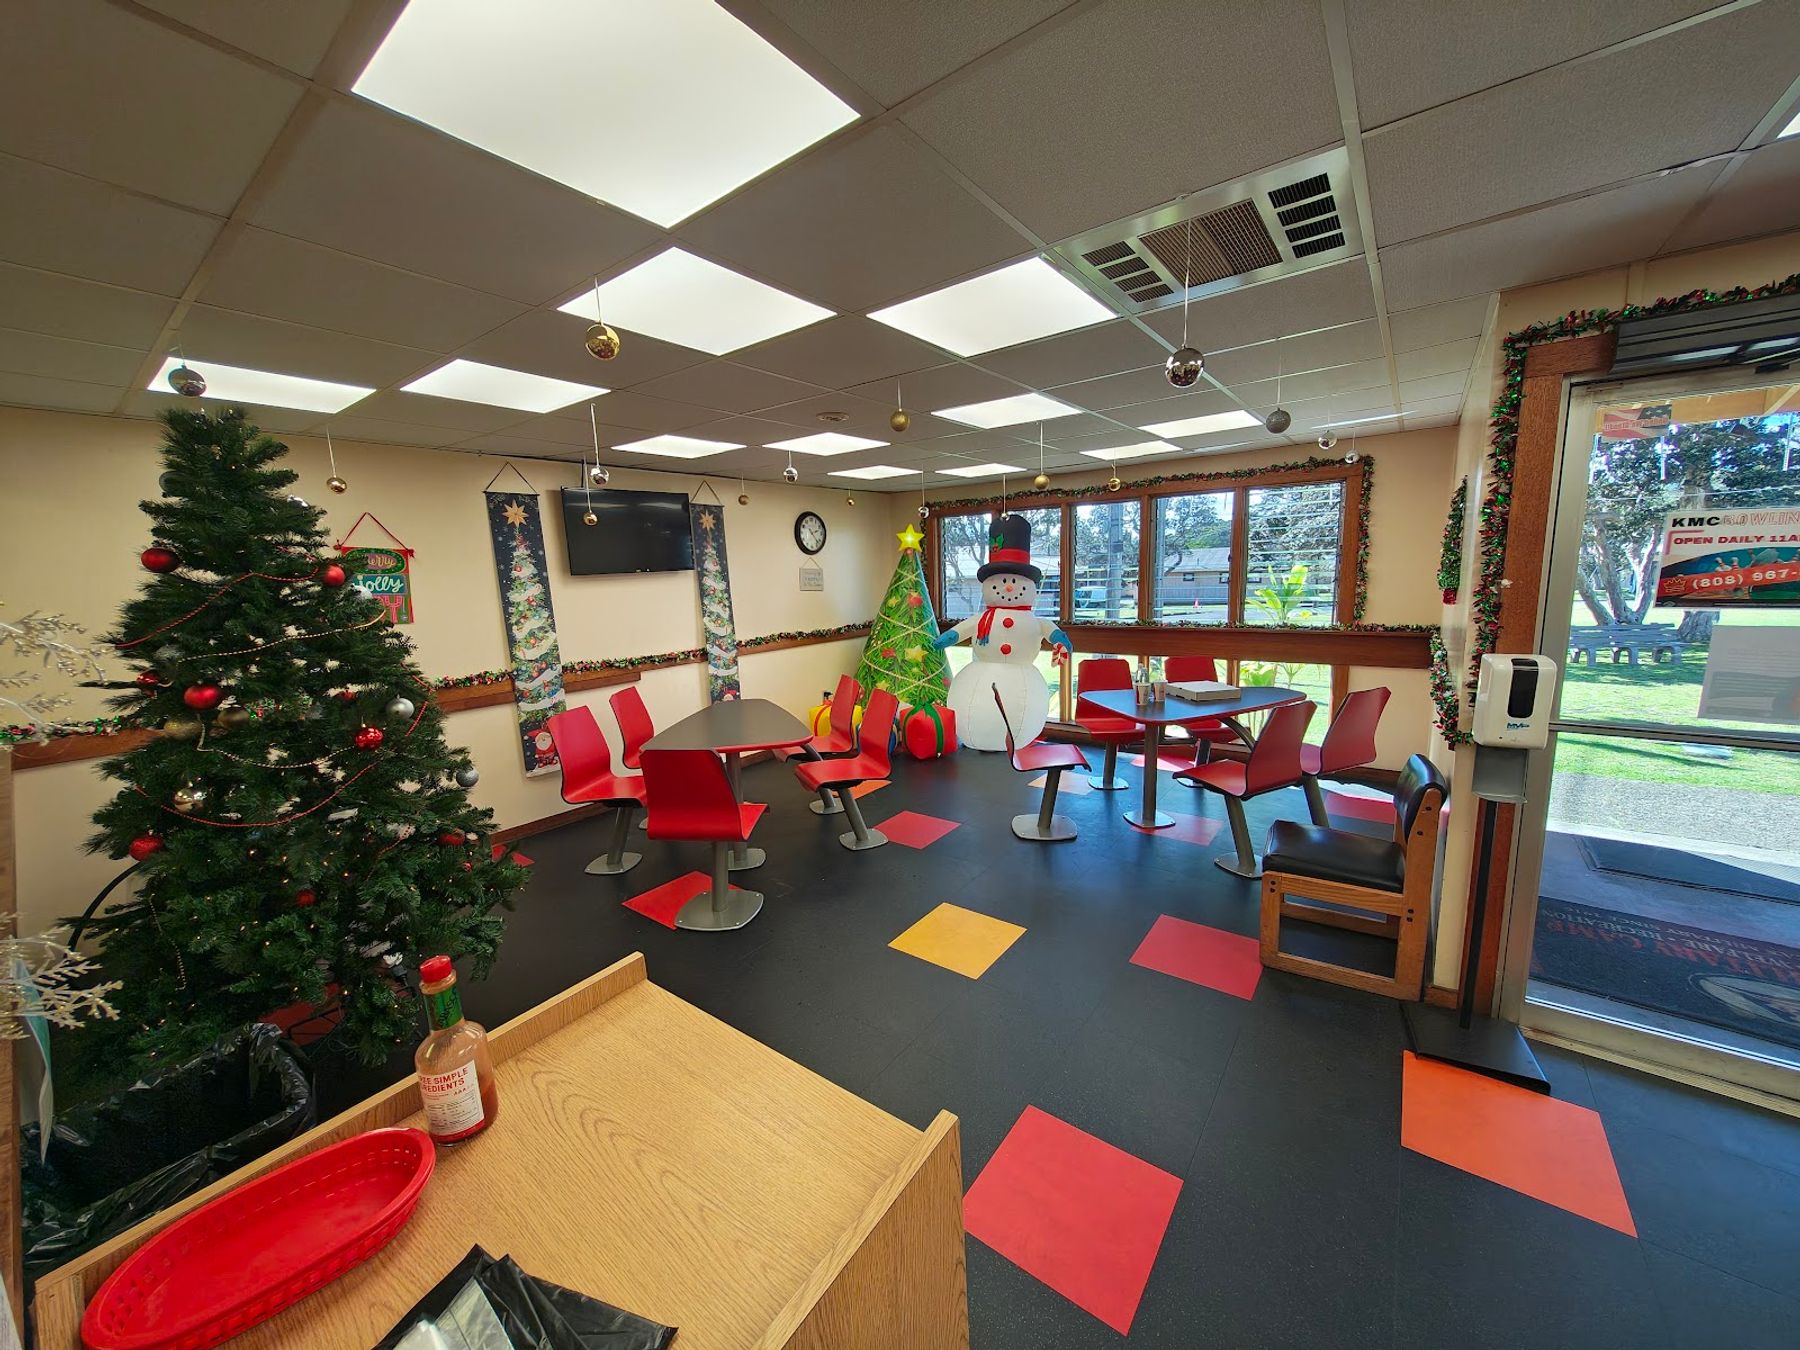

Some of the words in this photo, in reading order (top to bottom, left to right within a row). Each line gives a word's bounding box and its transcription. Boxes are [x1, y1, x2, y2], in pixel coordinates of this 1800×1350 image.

[1671, 516, 1720, 528] KMC
[1673, 537, 1714, 545] OPEN
[1717, 535, 1764, 544] DAILY
[1692, 574, 1744, 589] (808)
[433, 1066, 469, 1085] SIMPLE
[421, 1077, 465, 1093] REDIENTS
